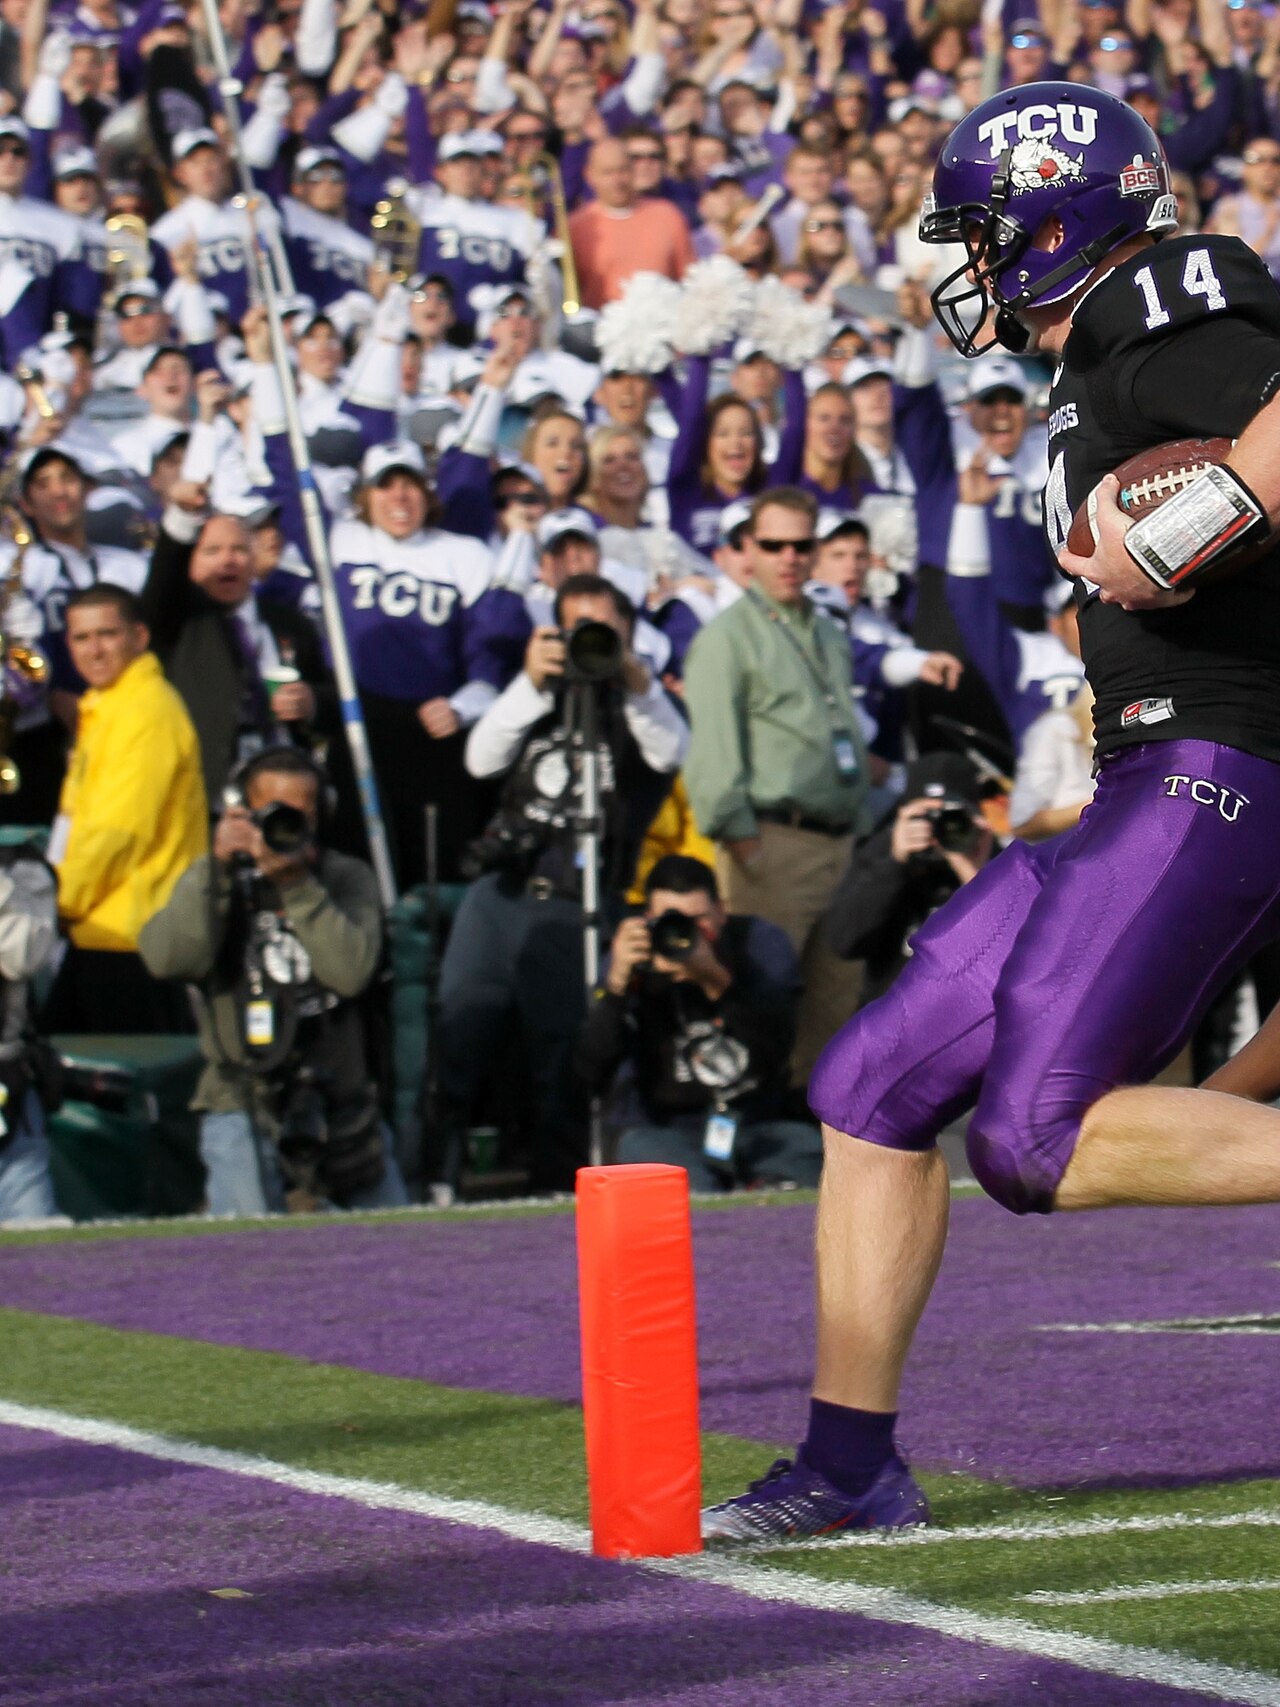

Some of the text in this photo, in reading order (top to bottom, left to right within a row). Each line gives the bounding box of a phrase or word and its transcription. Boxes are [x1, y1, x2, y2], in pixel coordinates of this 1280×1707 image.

[977, 104, 1099, 159] TCU
[1125, 171, 1157, 188] BCS
[436, 228, 513, 272] TCU
[1134, 248, 1228, 331] 14
[348, 566, 458, 628] TCU
[1163, 775, 1245, 822] TCU
